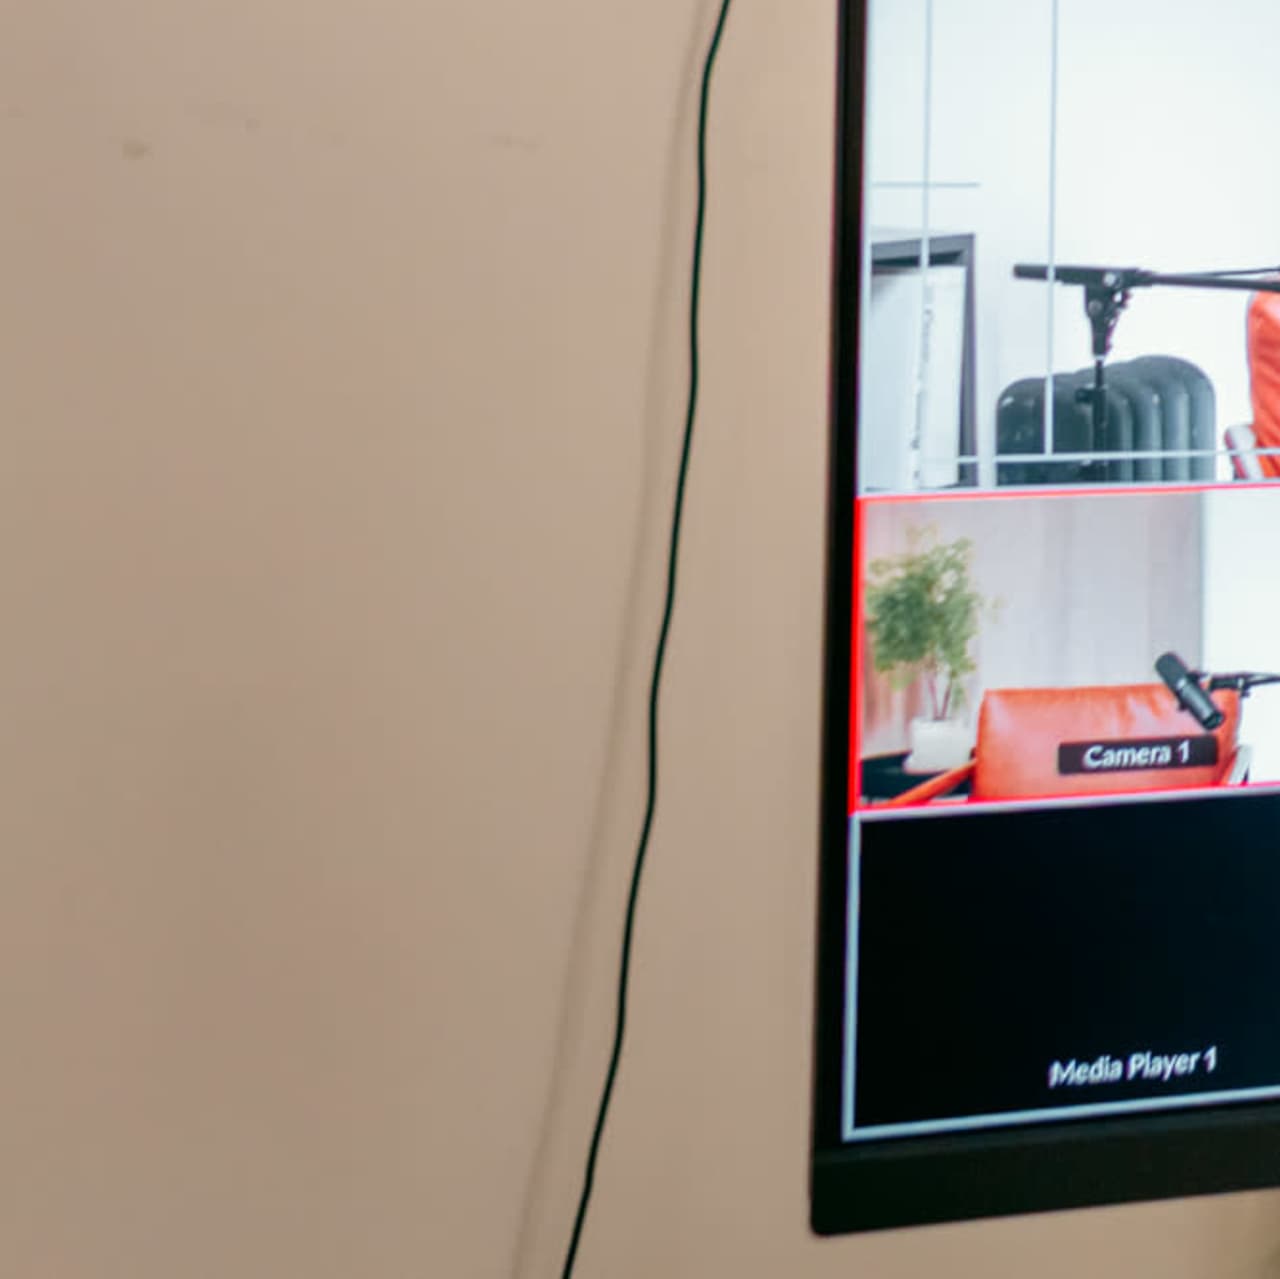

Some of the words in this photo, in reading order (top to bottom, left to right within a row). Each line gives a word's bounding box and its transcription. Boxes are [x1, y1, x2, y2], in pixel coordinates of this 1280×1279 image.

[1084, 744, 1171, 769] Camera
[1179, 740, 1189, 762] 1
[1050, 1056, 1122, 1086] Media
[1128, 1052, 1200, 1080] Player
[1205, 1047, 1216, 1070] 1
